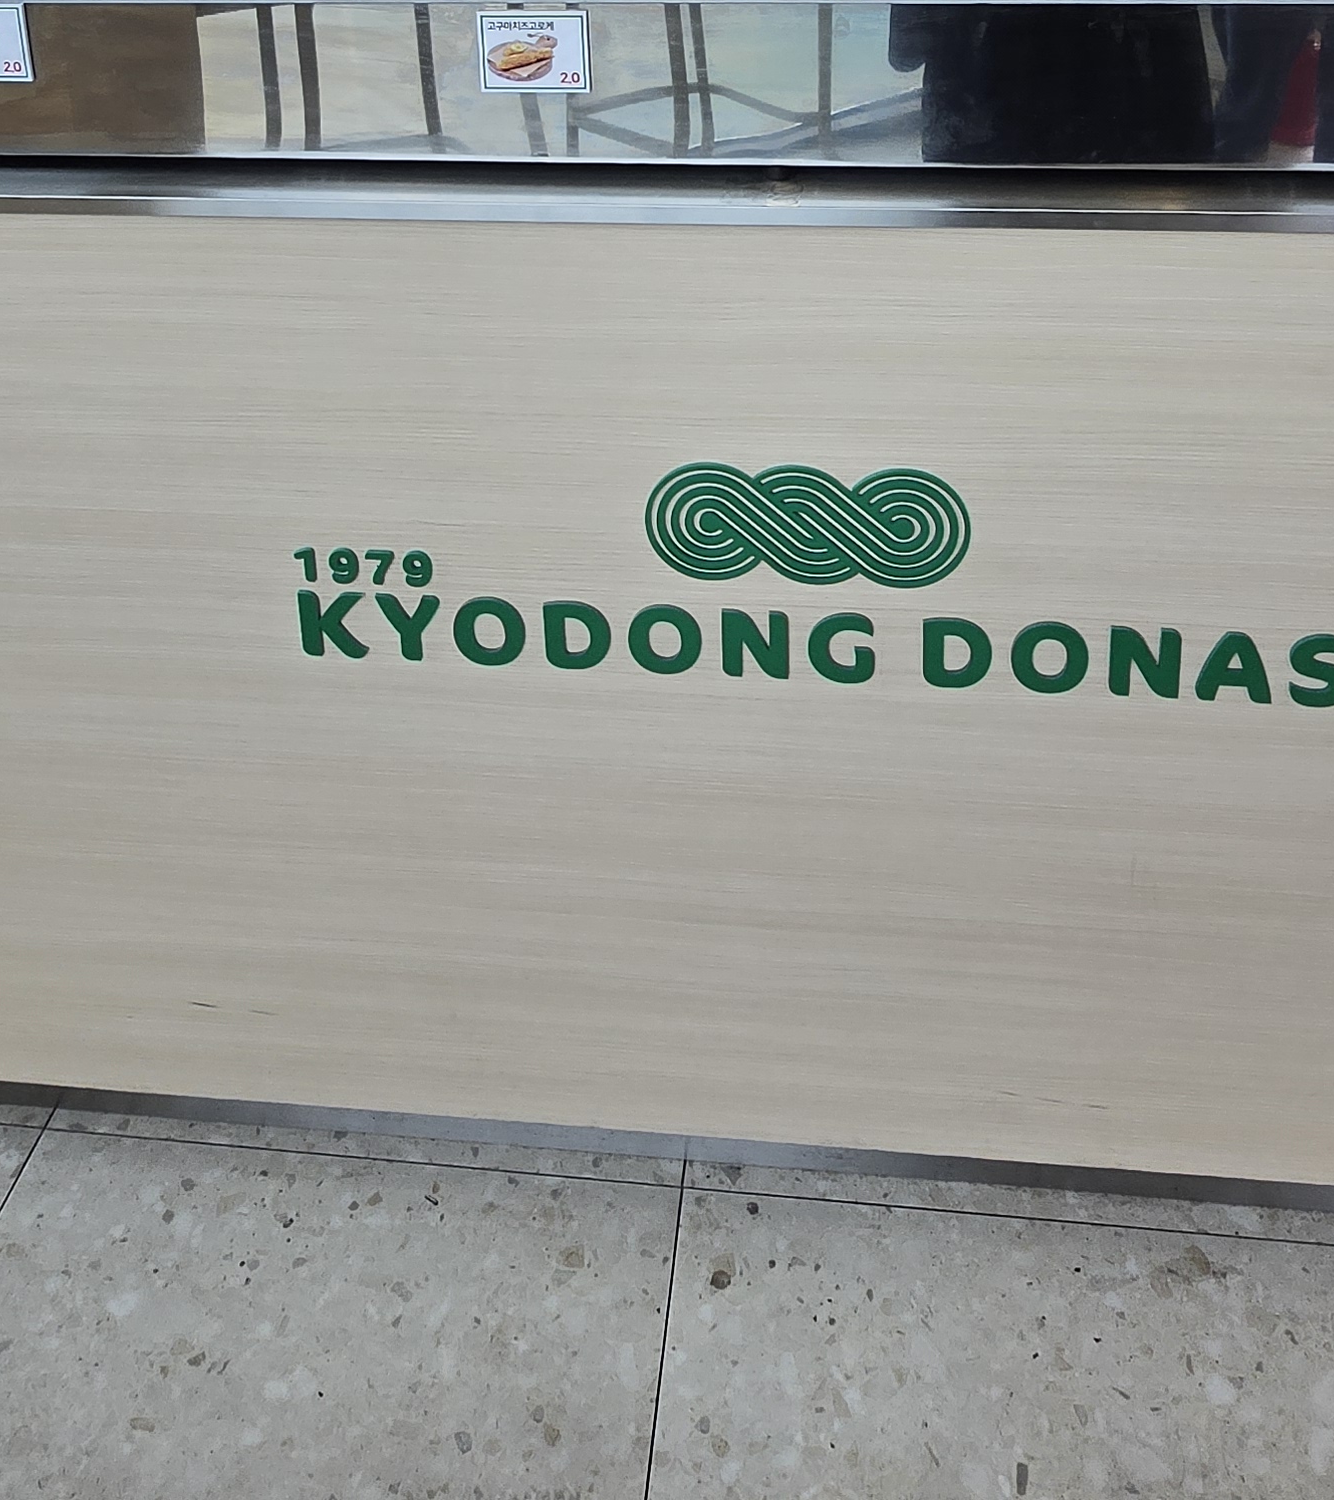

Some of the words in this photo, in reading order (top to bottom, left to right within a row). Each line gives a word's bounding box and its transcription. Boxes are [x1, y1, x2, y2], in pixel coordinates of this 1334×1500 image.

[487, 20, 554, 31] 고구마치즈고로케
[3, 61, 22, 74] 2.0
[560, 71, 580, 86] 2.0
[293, 546, 434, 590] 1979
[296, 589, 876, 686] KYODONG
